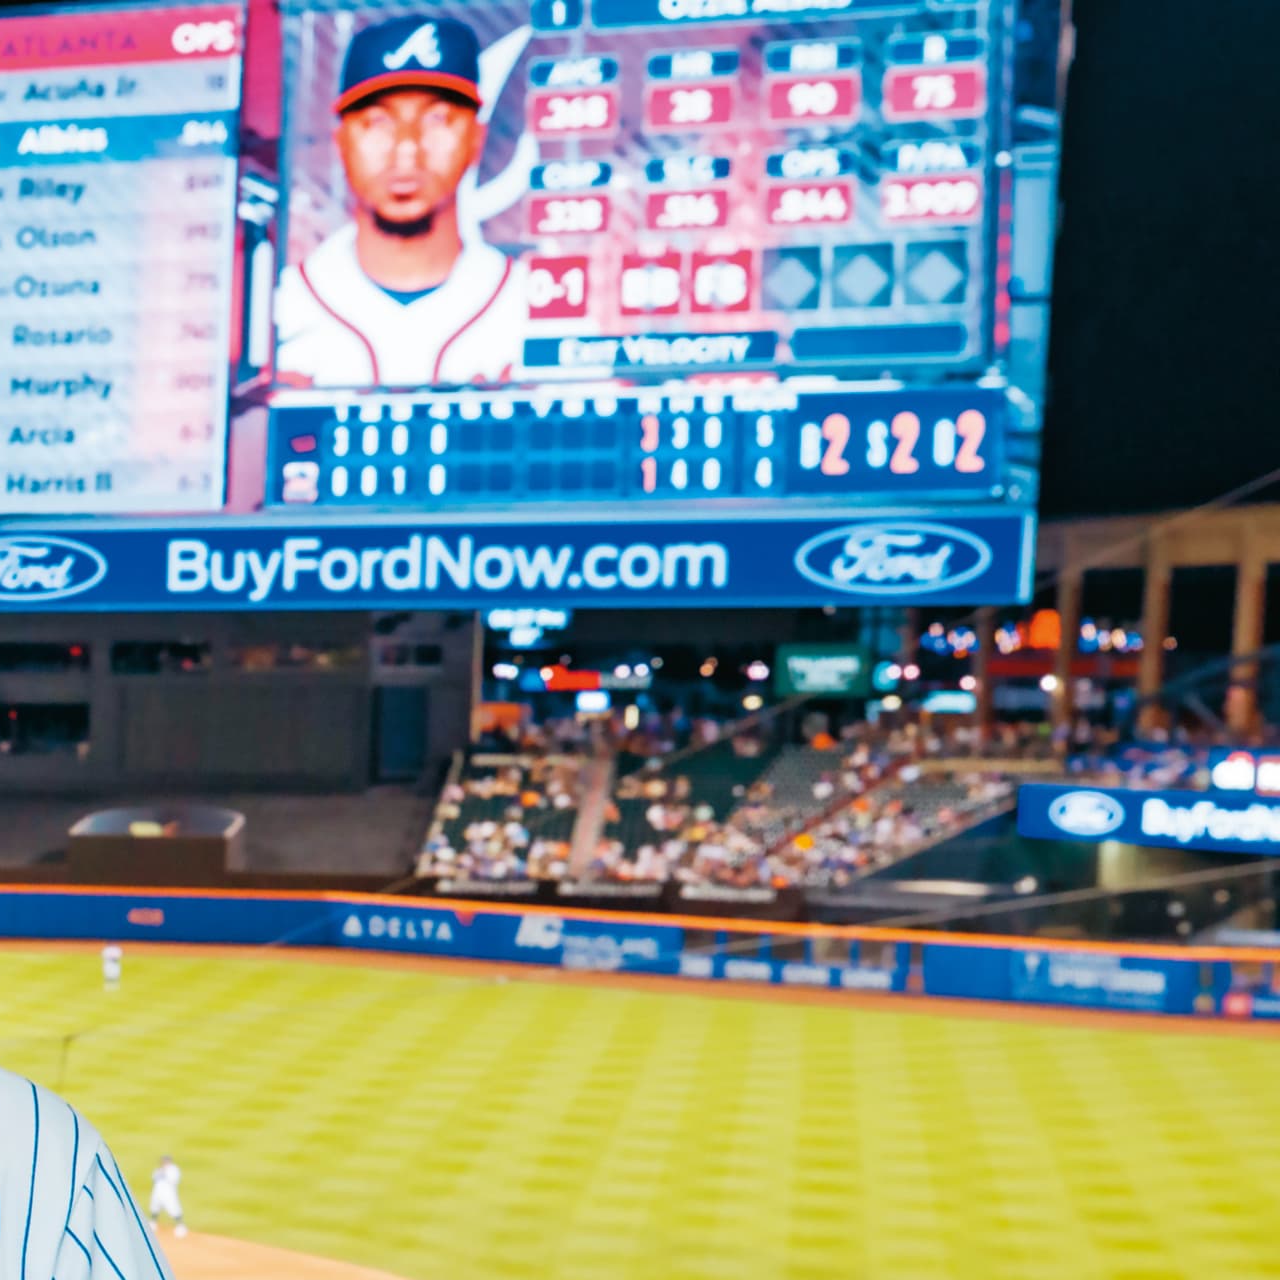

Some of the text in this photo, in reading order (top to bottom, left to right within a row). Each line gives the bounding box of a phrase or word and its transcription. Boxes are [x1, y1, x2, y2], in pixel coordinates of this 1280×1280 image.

[2, 31, 138, 57] ATLANTA
[18, 178, 87, 205] Riley
[15, 225, 97, 250] Olson
[12, 323, 113, 347] Rosario
[9, 372, 113, 400] Murphy
[7, 426, 75, 446] Arcia
[821, 413, 850, 475] 2
[890, 411, 920, 474] 2
[955, 409, 985, 473] 2
[6, 472, 86, 494] Harris
[166, 533, 728, 602] BuyFordNow.com
[830, 530, 954, 583] Ford
[368, 914, 453, 941] DELTA
